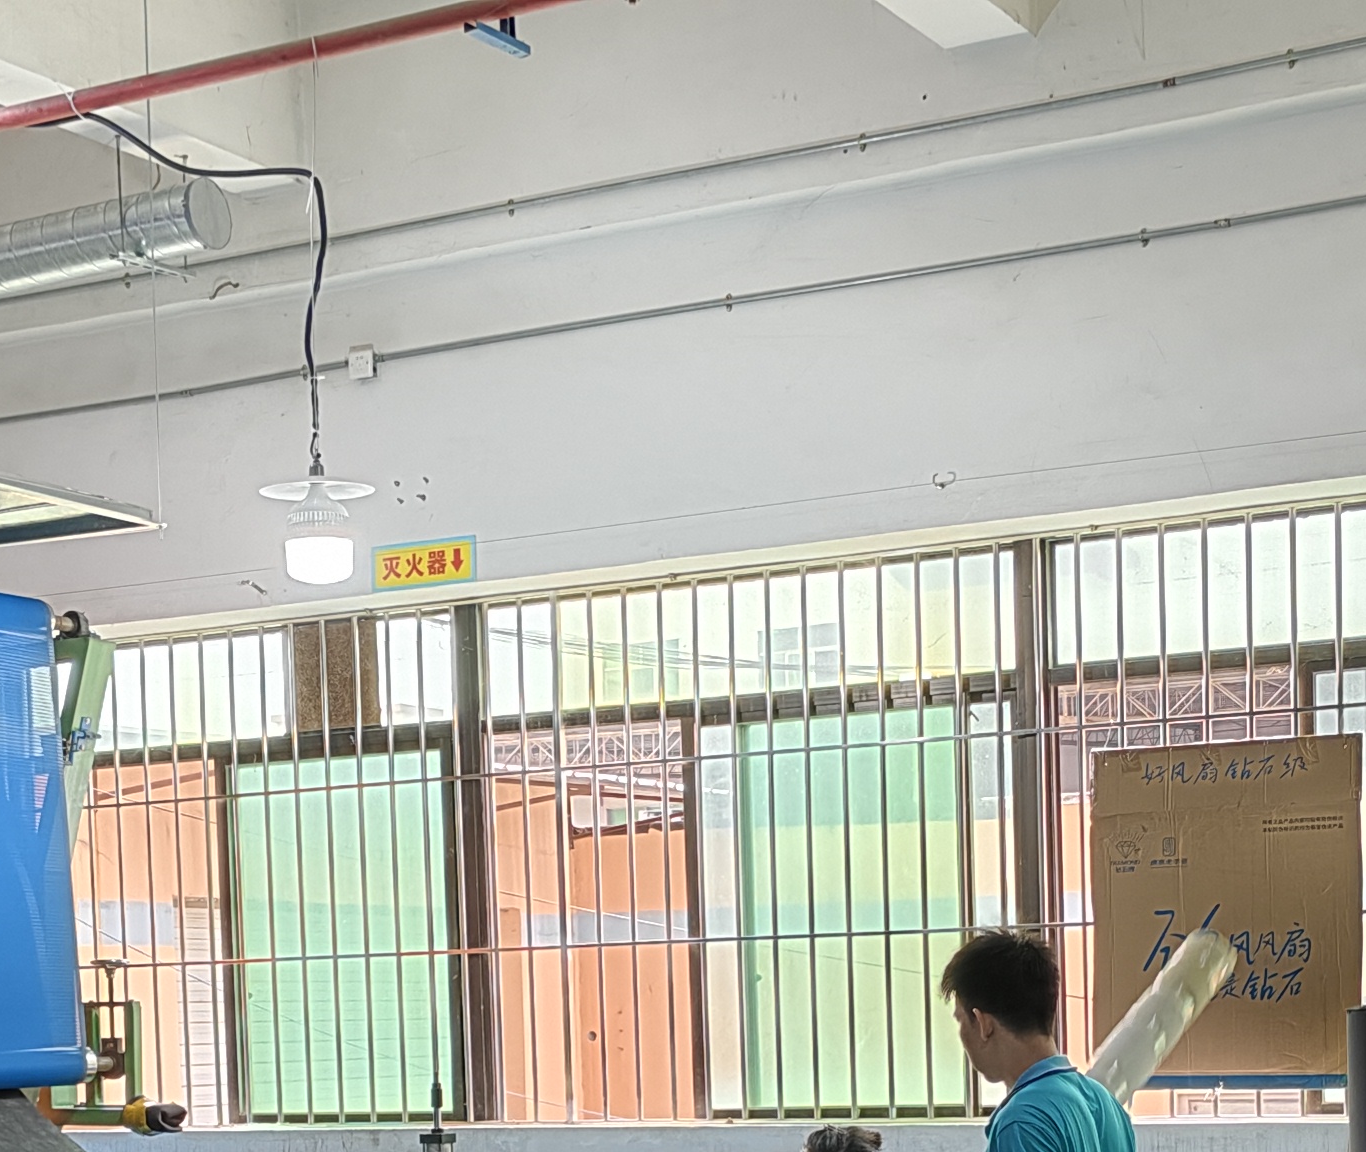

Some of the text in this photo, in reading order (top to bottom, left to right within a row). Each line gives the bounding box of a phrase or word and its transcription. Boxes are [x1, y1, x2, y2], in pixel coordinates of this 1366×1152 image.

[382, 550, 447, 581] 灭火器
[1141, 754, 1308, 785] 好风扇钻石级
